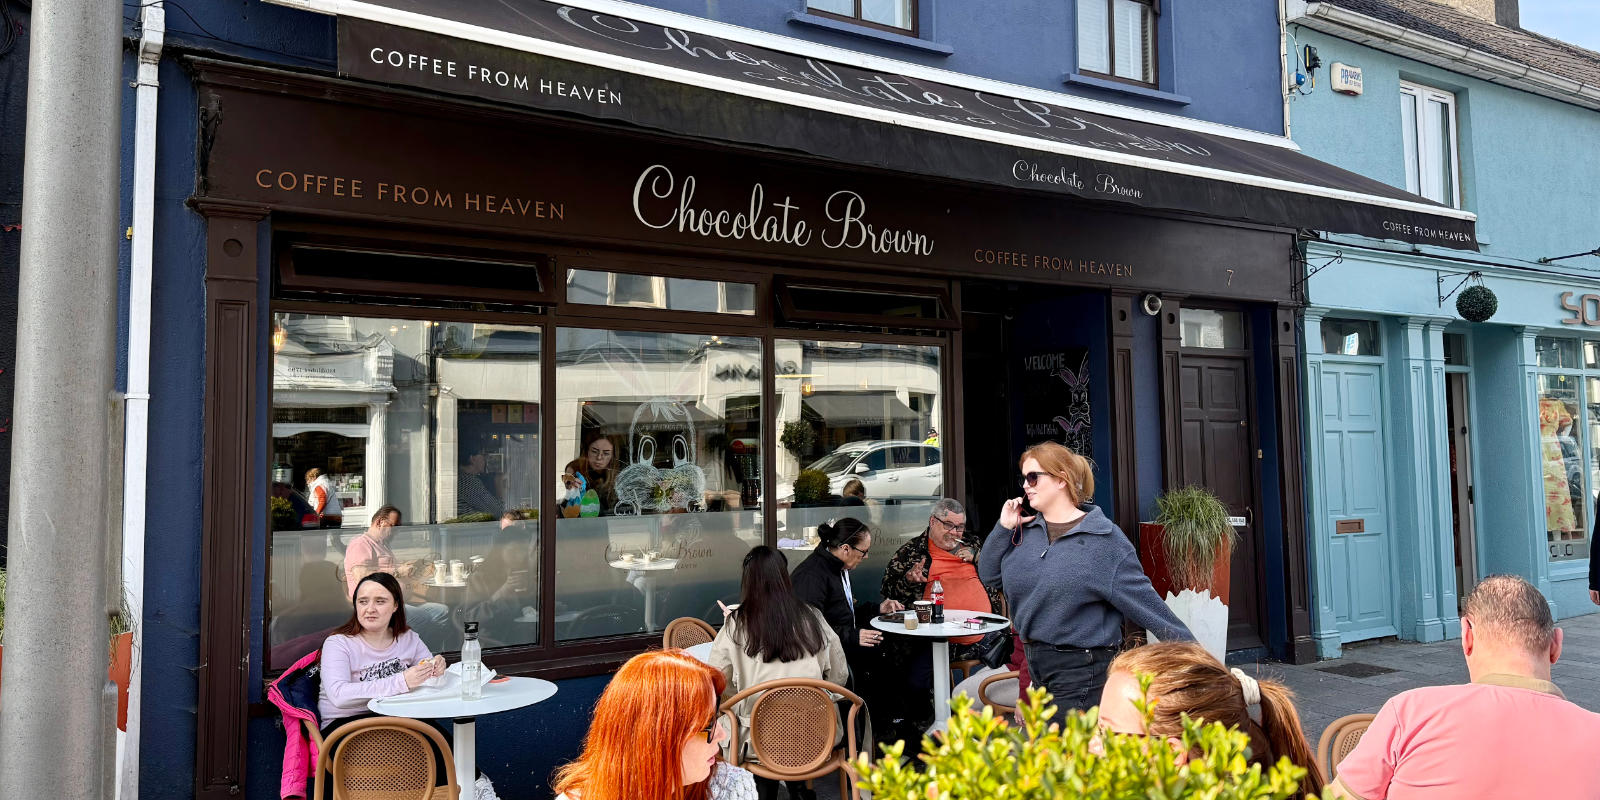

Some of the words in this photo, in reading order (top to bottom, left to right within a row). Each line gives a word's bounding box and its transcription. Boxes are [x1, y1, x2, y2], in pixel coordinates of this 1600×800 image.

[370, 47, 457, 78] COFFEE
[468, 65, 529, 91] FROM
[540, 79, 622, 105] HEAVEN
[255, 169, 363, 199] COFFEE
[377, 182, 453, 208] FROM
[465, 193, 565, 221] HEAVEN
[1012, 160, 1084, 190] Chocolate
[1094, 173, 1143, 199] Brown
[633, 164, 812, 247] Chocolate
[821, 190, 934, 255] Brown
[1382, 220, 1412, 235] COFFEE
[1414, 226, 1437, 239] FROM
[1438, 230, 1471, 242] HEAVEN
[974, 249, 1029, 268] COFFEE
[1034, 255, 1074, 272] FROM
[1079, 260, 1134, 278] HEAVEN
[1226, 269, 1234, 288] 7
[1024, 353, 1065, 371] WELCOME
